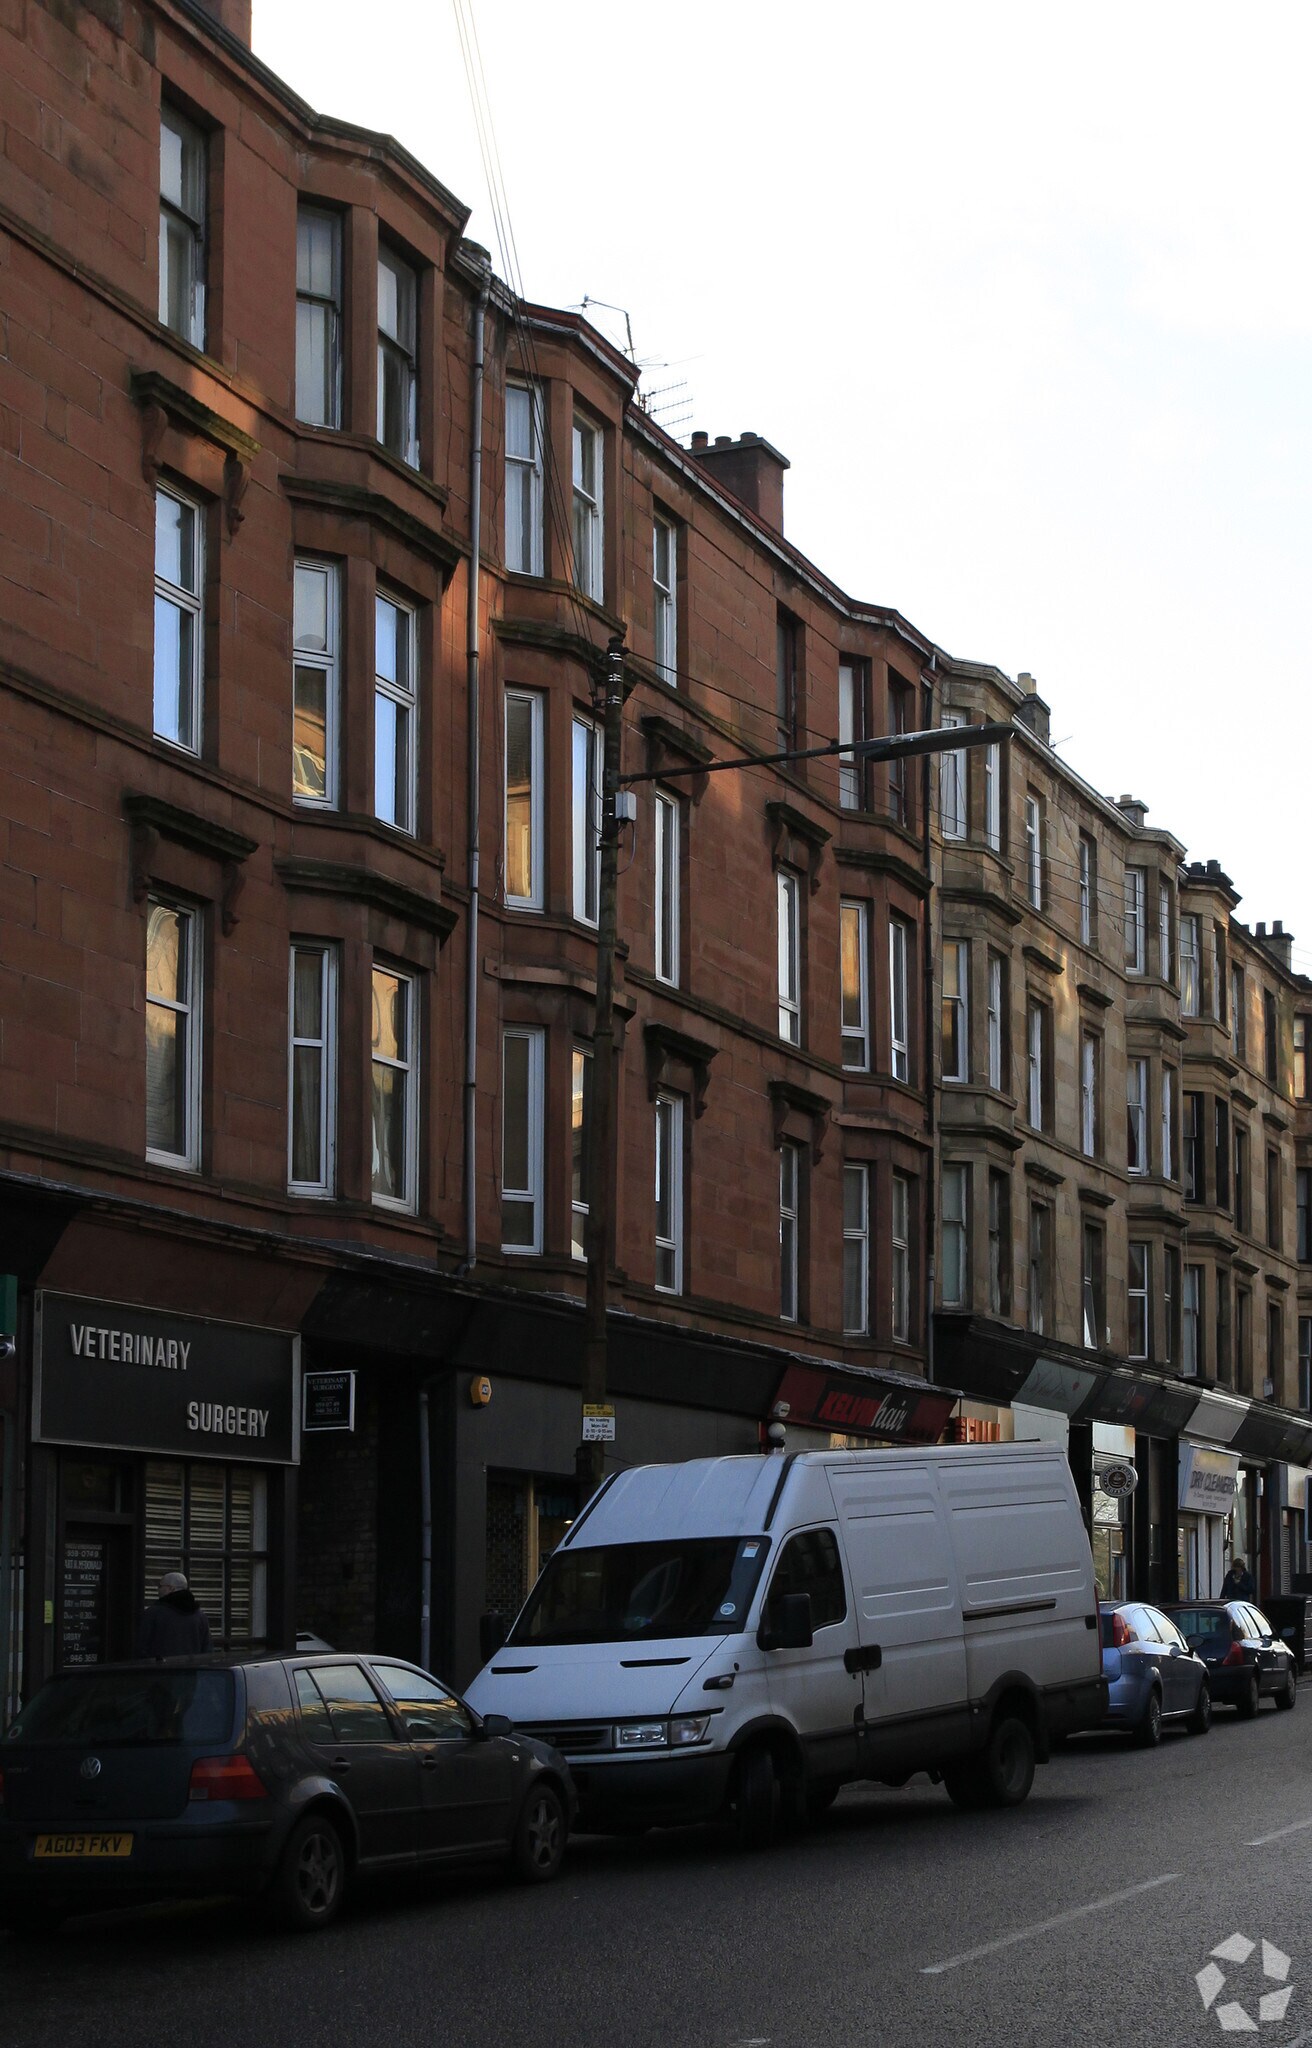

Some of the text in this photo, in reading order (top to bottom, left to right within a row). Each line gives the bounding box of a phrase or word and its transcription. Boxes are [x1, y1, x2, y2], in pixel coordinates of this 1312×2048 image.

[70, 1323, 191, 1371] VETERINARY
[187, 1401, 270, 1438] SURGERY
[871, 1392, 909, 1432] hair
[1190, 1471, 1236, 1496] DRY CLEANERS
[44, 1836, 122, 1854] AG03 FKV
